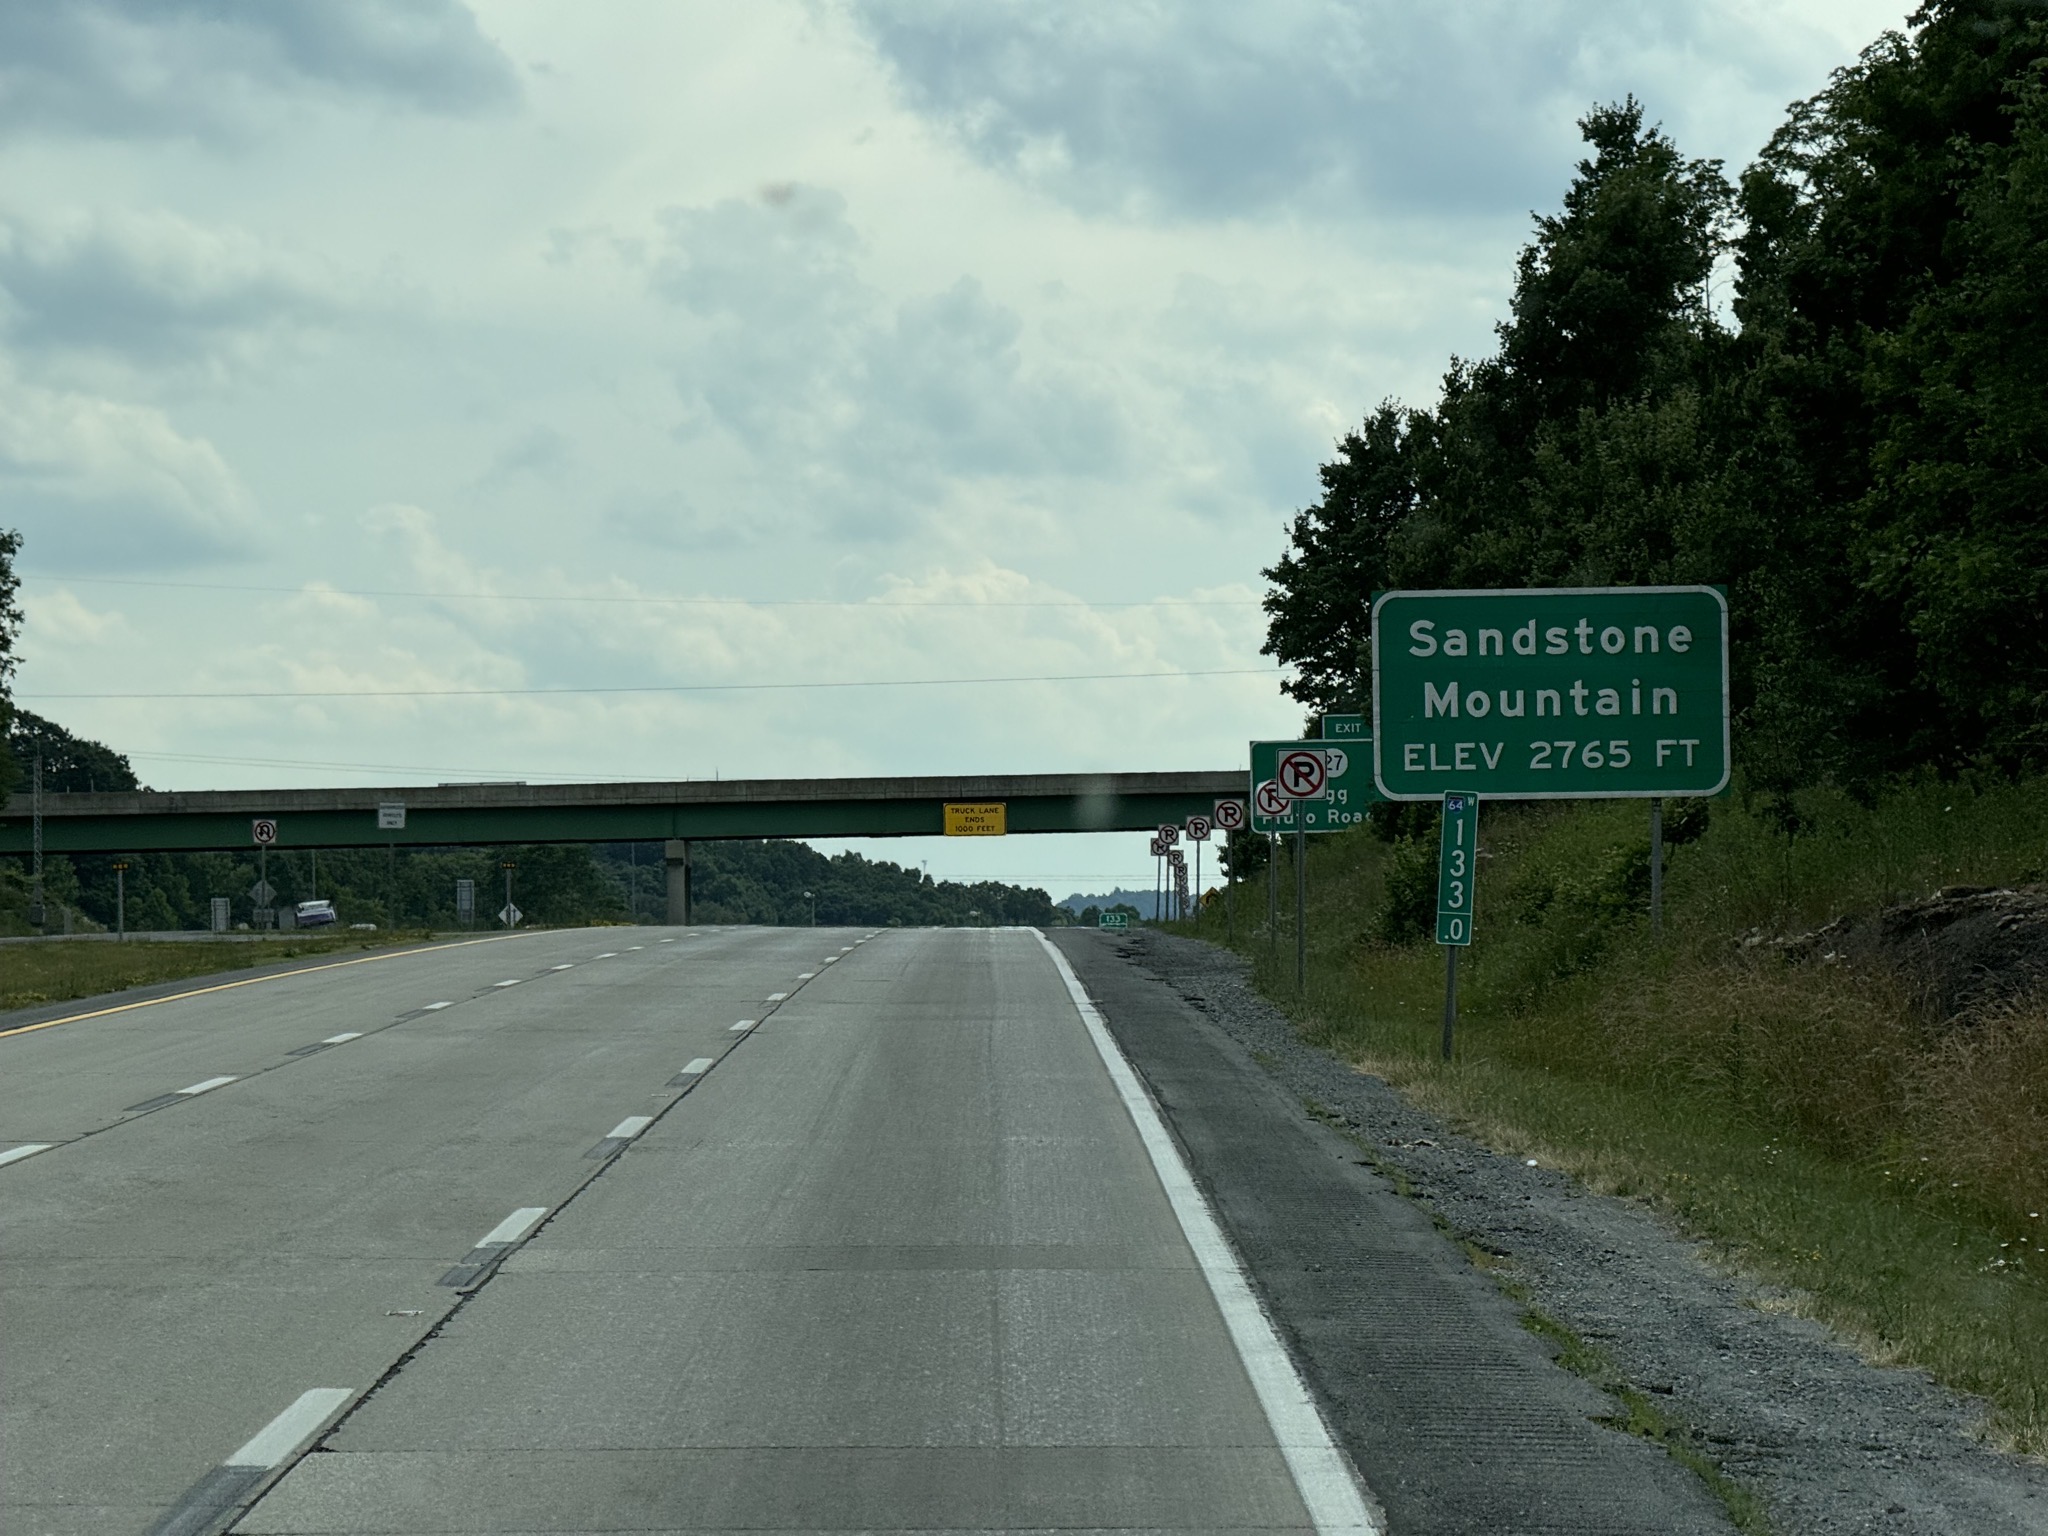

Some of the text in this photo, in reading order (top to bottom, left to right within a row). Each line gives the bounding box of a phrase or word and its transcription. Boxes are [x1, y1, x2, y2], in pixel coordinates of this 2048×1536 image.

[1408, 618, 1693, 657] Sandstone
[1424, 679, 1678, 718] Mountain
[1335, 723, 1361, 733] EXIT
[1404, 739, 1700, 771] ELEV 2765 FT
[1448, 796, 1475, 811] 64 W
